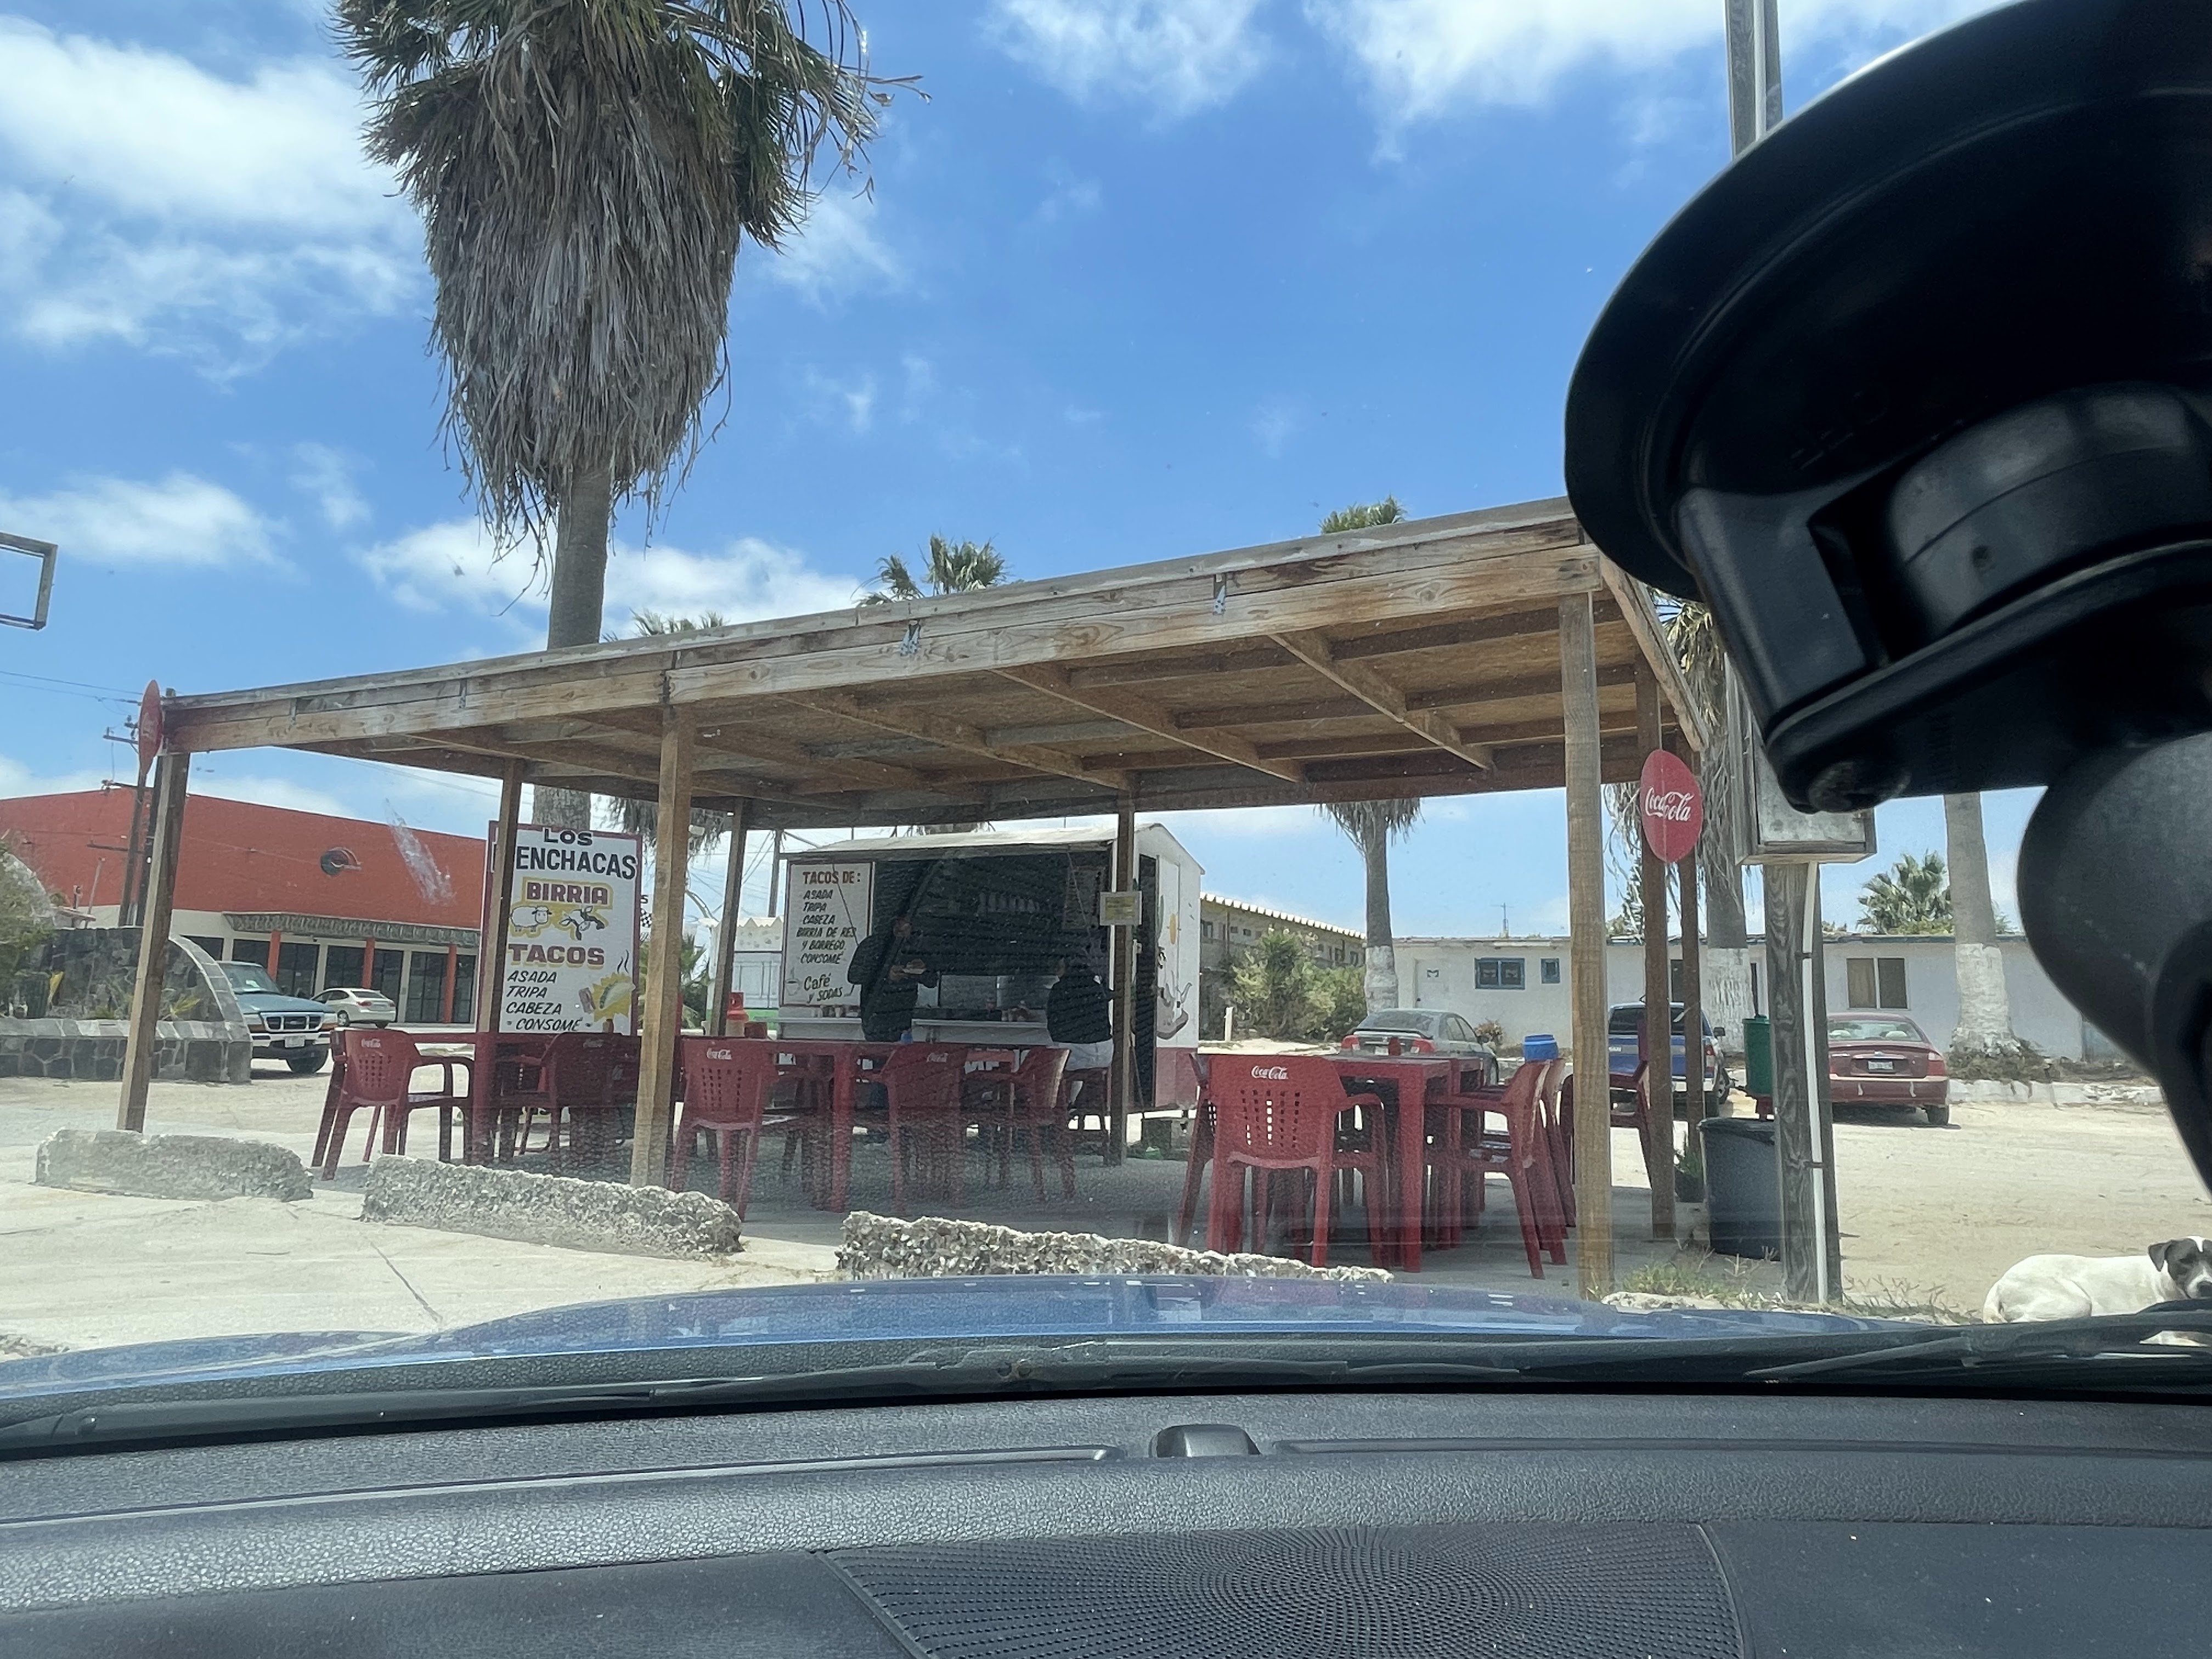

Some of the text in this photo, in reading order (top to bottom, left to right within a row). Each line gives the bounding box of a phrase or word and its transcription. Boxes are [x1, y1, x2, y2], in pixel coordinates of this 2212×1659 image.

[544, 828, 592, 846] LOS
[492, 843, 636, 880] ENCHACAS
[803, 871, 839, 884] TACOS
[526, 882, 608, 905] BIRRIA
[803, 889, 833, 900] ASADA
[803, 914, 836, 924] CABEZA
[826, 927, 839, 938] DE
[508, 944, 605, 965] TACOS
[507, 970, 557, 983] ASADA
[804, 973, 832, 991] Café
[506, 985, 548, 998] TRIPA
[506, 1001, 562, 1015] CABEZA
